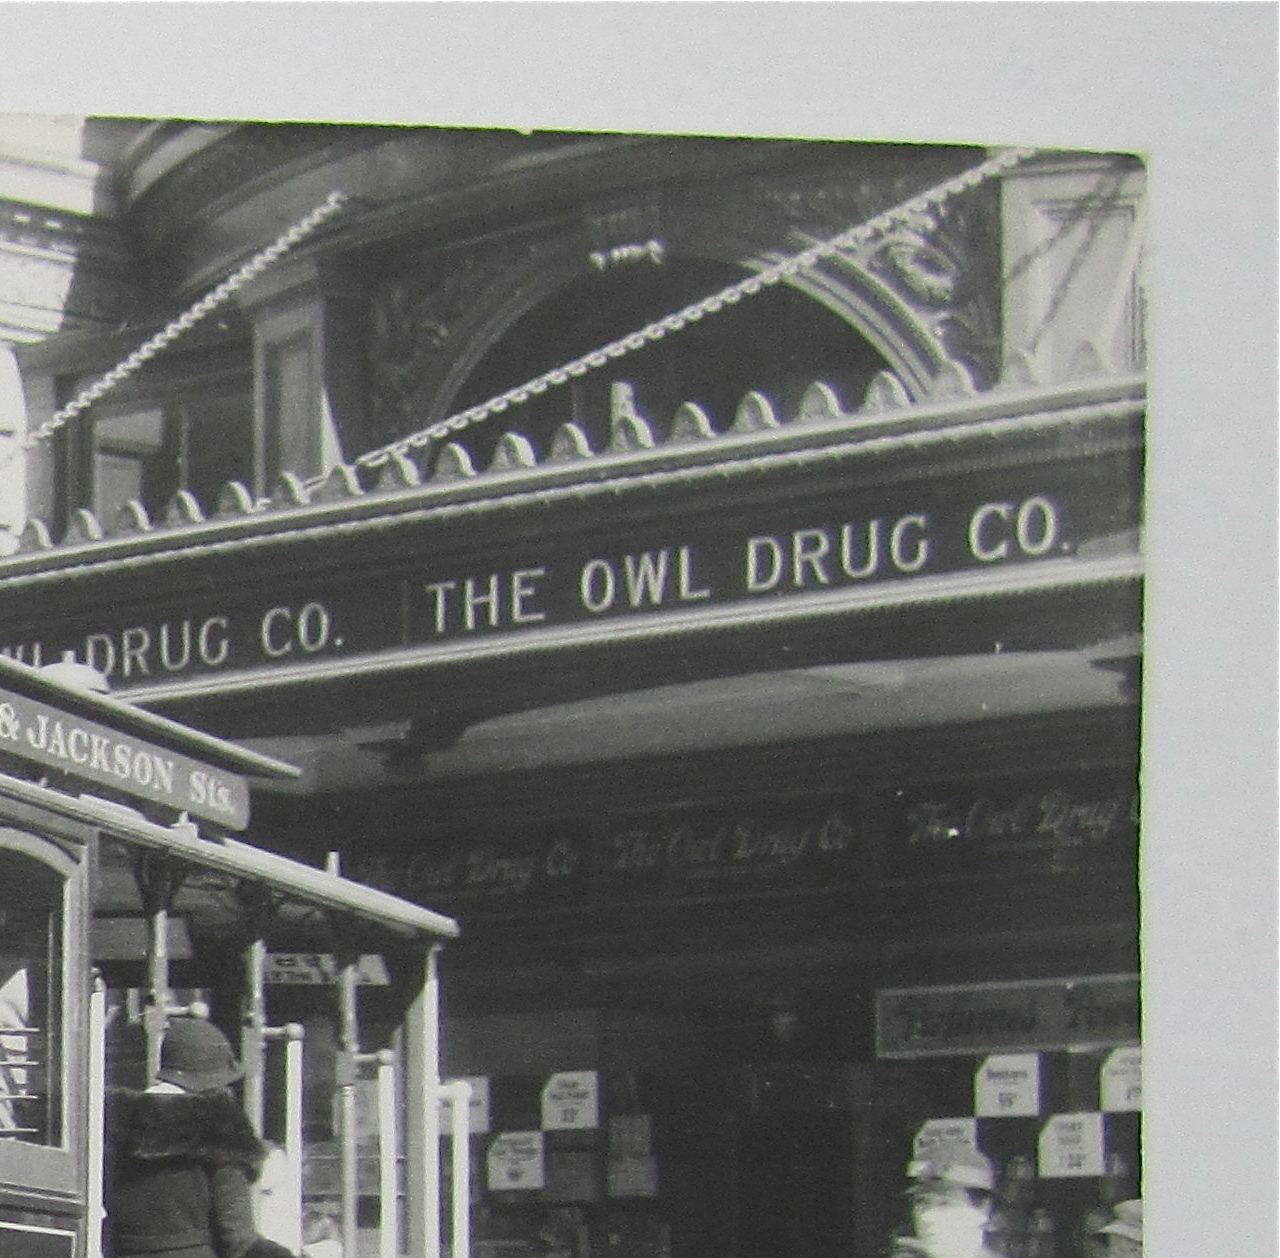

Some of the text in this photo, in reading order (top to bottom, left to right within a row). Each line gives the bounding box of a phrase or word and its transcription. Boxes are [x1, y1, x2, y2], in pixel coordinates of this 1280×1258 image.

[426, 497, 1073, 633] THE OWL DRUG CO.
[86, 616, 229, 678] DRUG
[261, 603, 343, 656] CO.
[26, 712, 176, 795] JACKSON
[189, 769, 234, 818] Sts.
